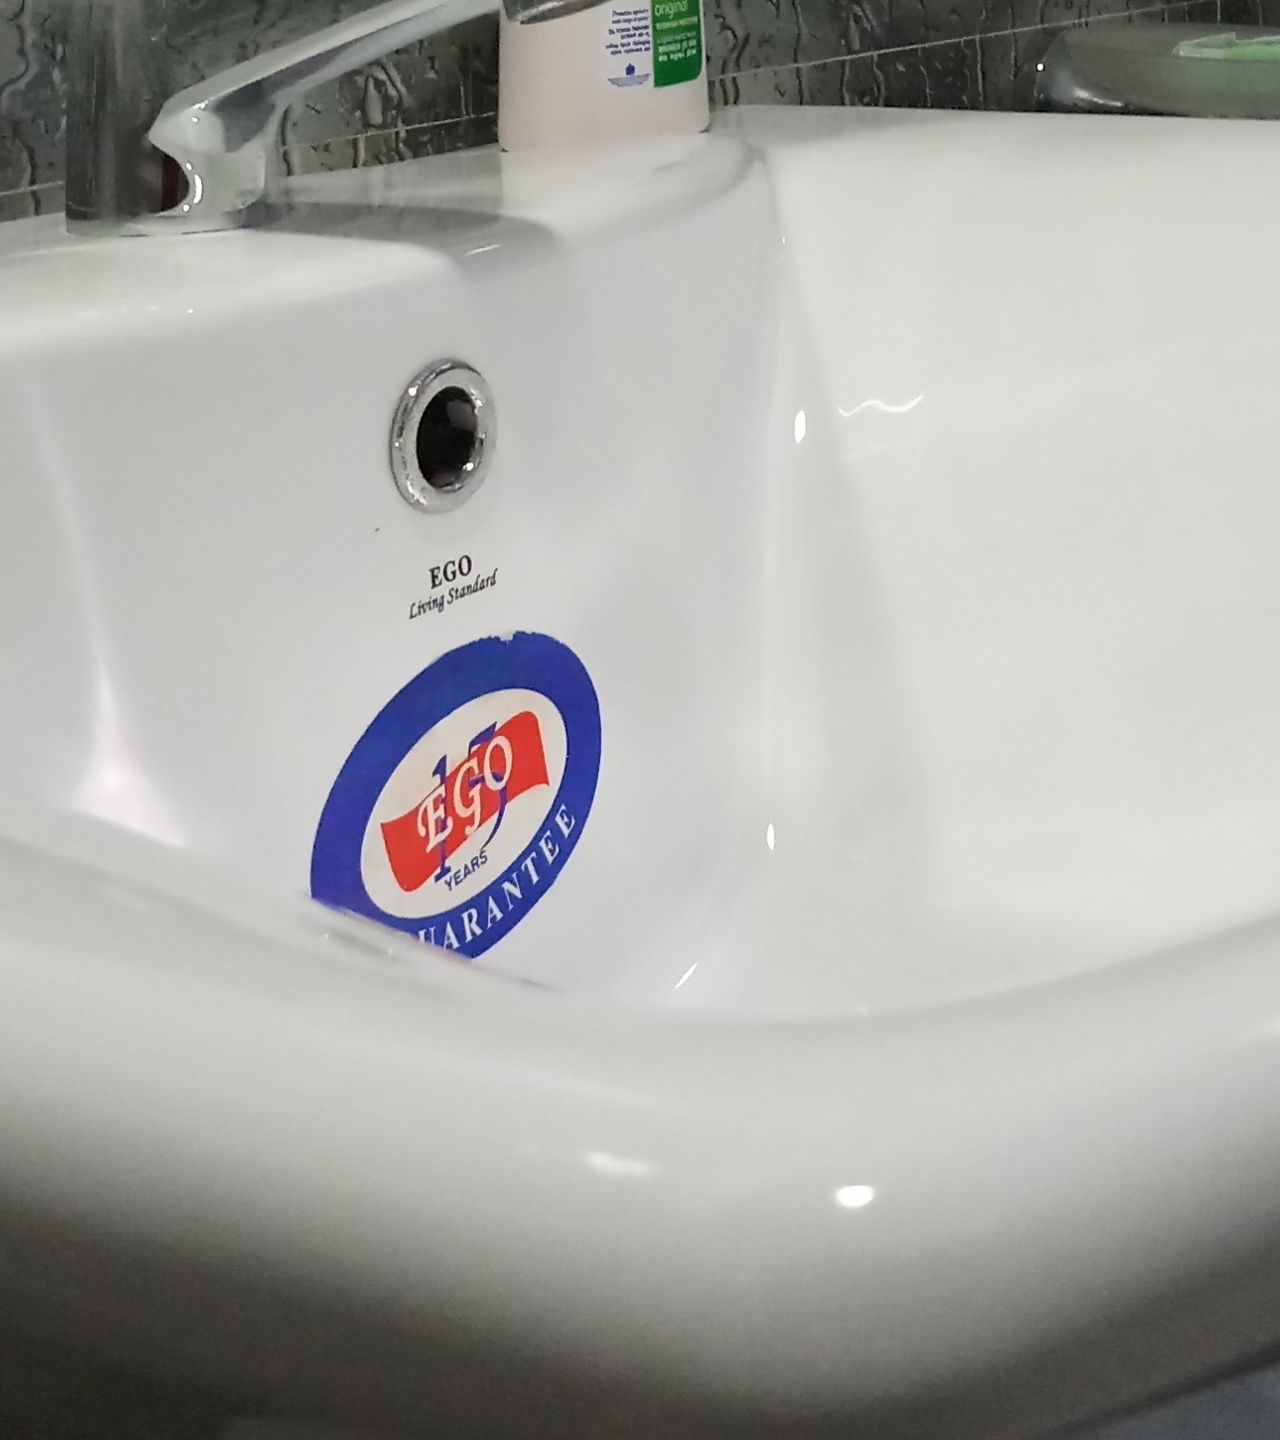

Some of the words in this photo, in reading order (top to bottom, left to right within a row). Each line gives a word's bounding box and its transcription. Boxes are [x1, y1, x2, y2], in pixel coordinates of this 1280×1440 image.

[409, 593, 445, 620] Living
[446, 567, 498, 606] Standard
[428, 554, 472, 590] EGO
[416, 734, 513, 853] EGO
[417, 803, 576, 951] UARANTEE
[444, 849, 489, 892] YEARS
